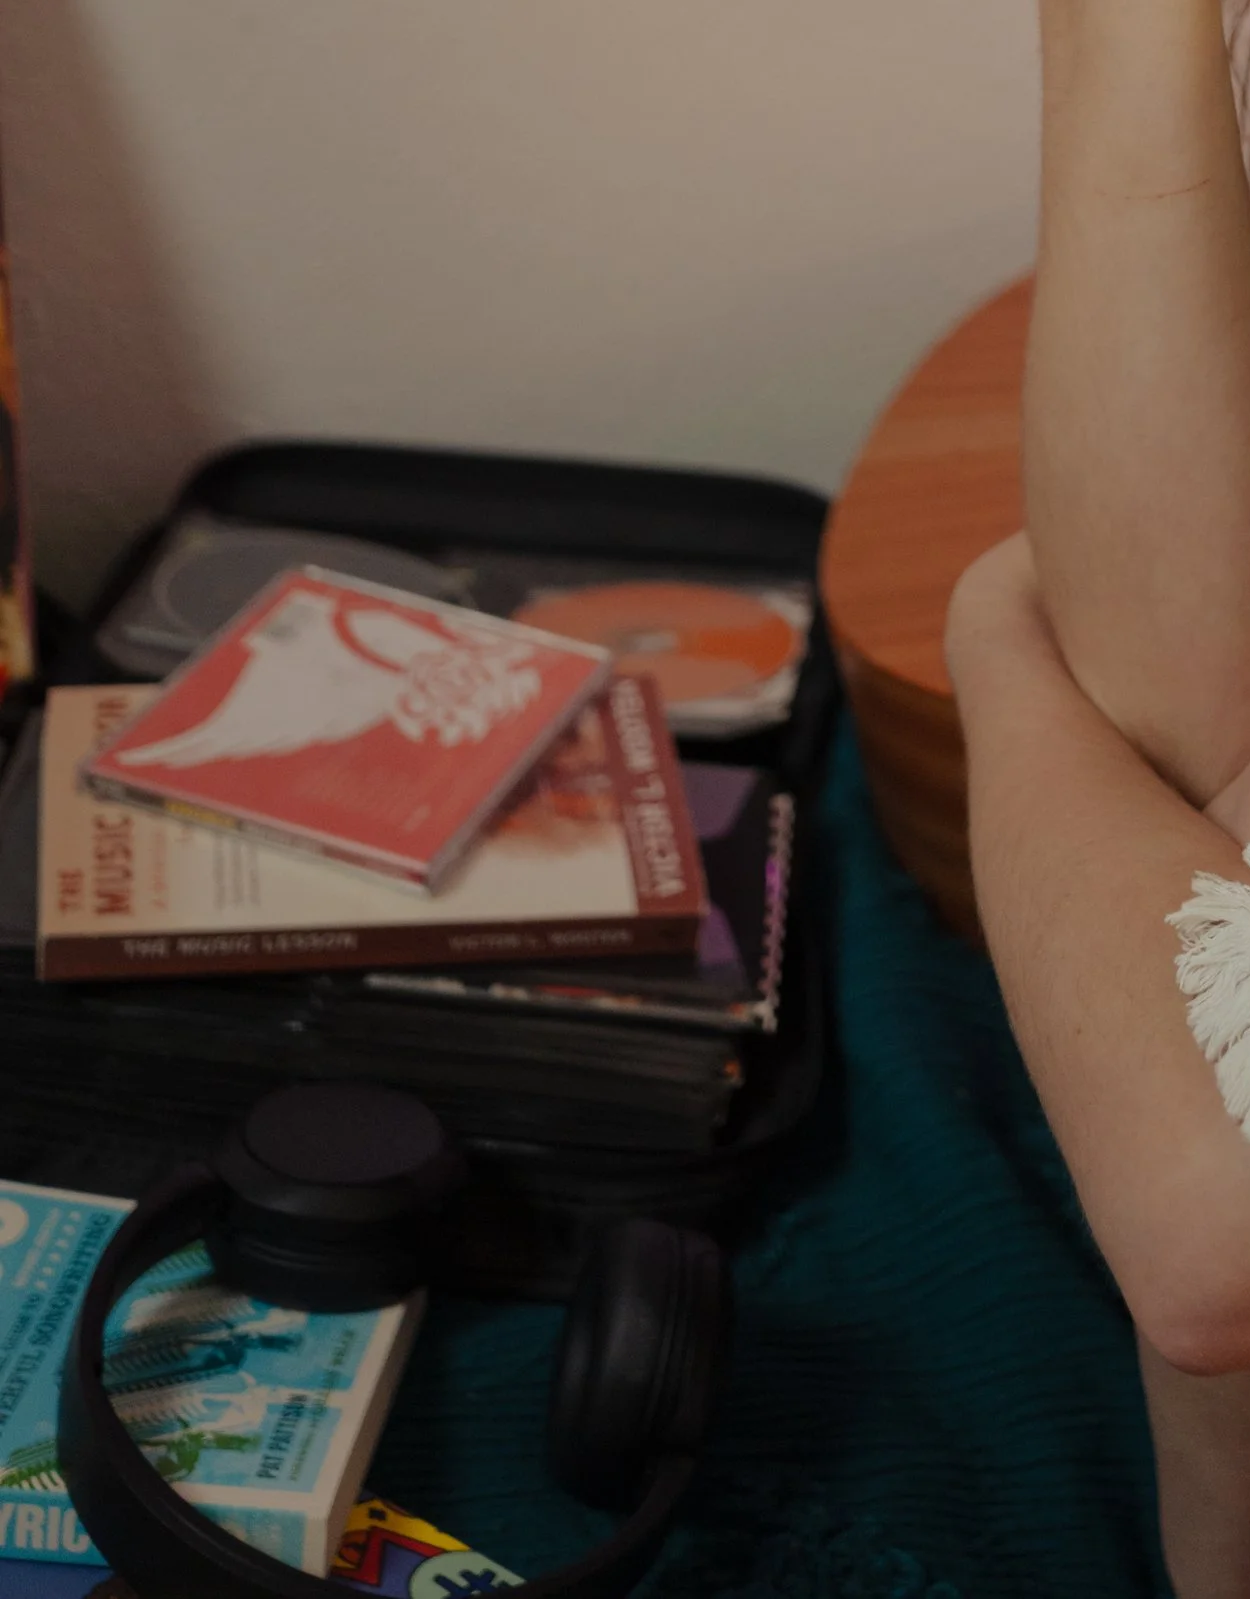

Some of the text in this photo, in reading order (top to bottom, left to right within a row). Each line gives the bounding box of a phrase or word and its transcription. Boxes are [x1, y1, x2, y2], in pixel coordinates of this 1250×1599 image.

[58, 869, 84, 917] THE
[92, 813, 134, 917] MUSIC
[176, 934, 255, 958] MUSIC
[261, 930, 358, 955] LESSON
[28, 1212, 112, 1347] SONGWRITING
[255, 1393, 308, 1480] PAT PATTISON
